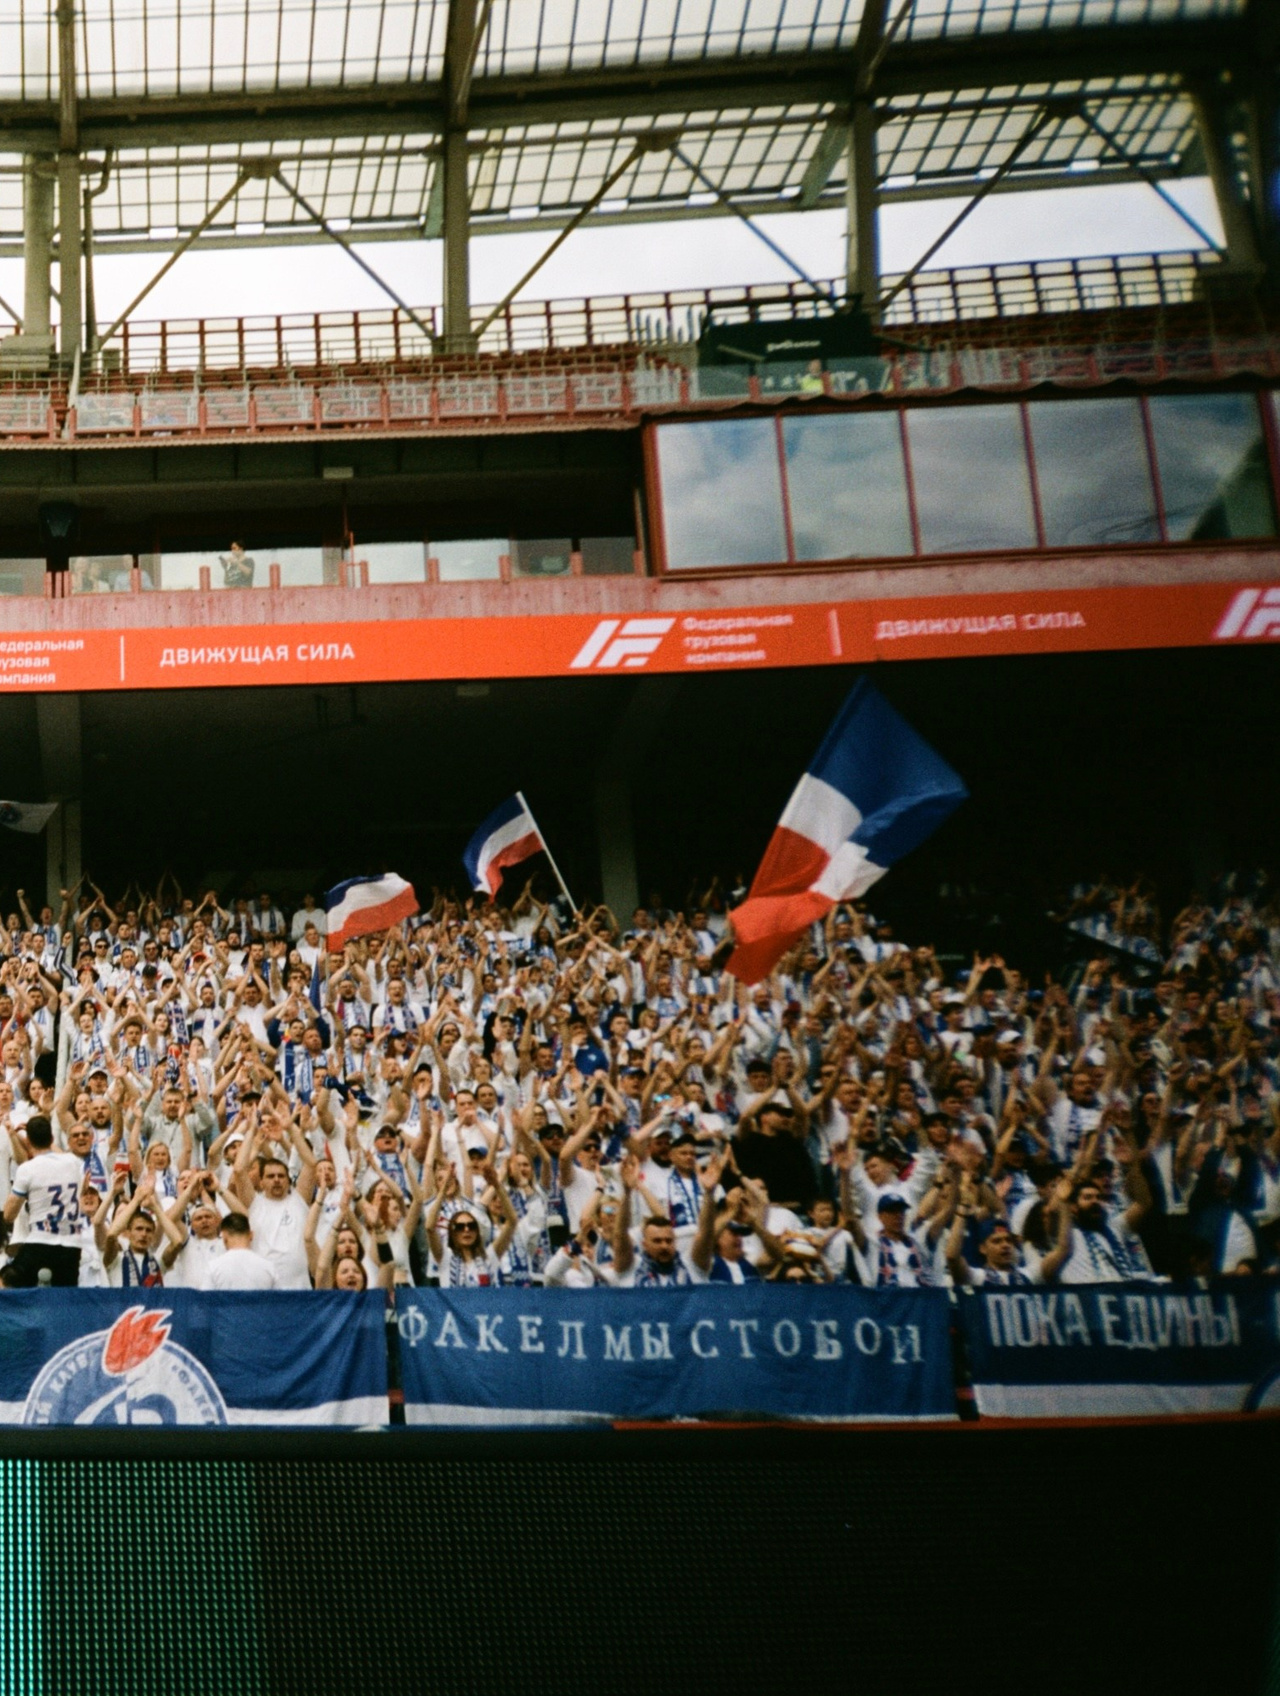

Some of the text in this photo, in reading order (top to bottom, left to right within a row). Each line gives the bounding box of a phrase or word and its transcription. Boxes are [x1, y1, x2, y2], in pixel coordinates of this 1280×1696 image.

[681, 614, 794, 632] Федеральная
[875, 611, 1087, 640] ДВИЖУЩАЯ СИЛА
[159, 642, 356, 668] ДВИЖУЩАЯ СИЛА
[683, 633, 757, 650] грузовая
[47, 1183, 79, 1223] 33
[397, 1304, 588, 1361] ФАКЕЛ
[984, 1292, 1094, 1348] ПОКА
[1096, 1293, 1243, 1351] ЕДИНЫ
